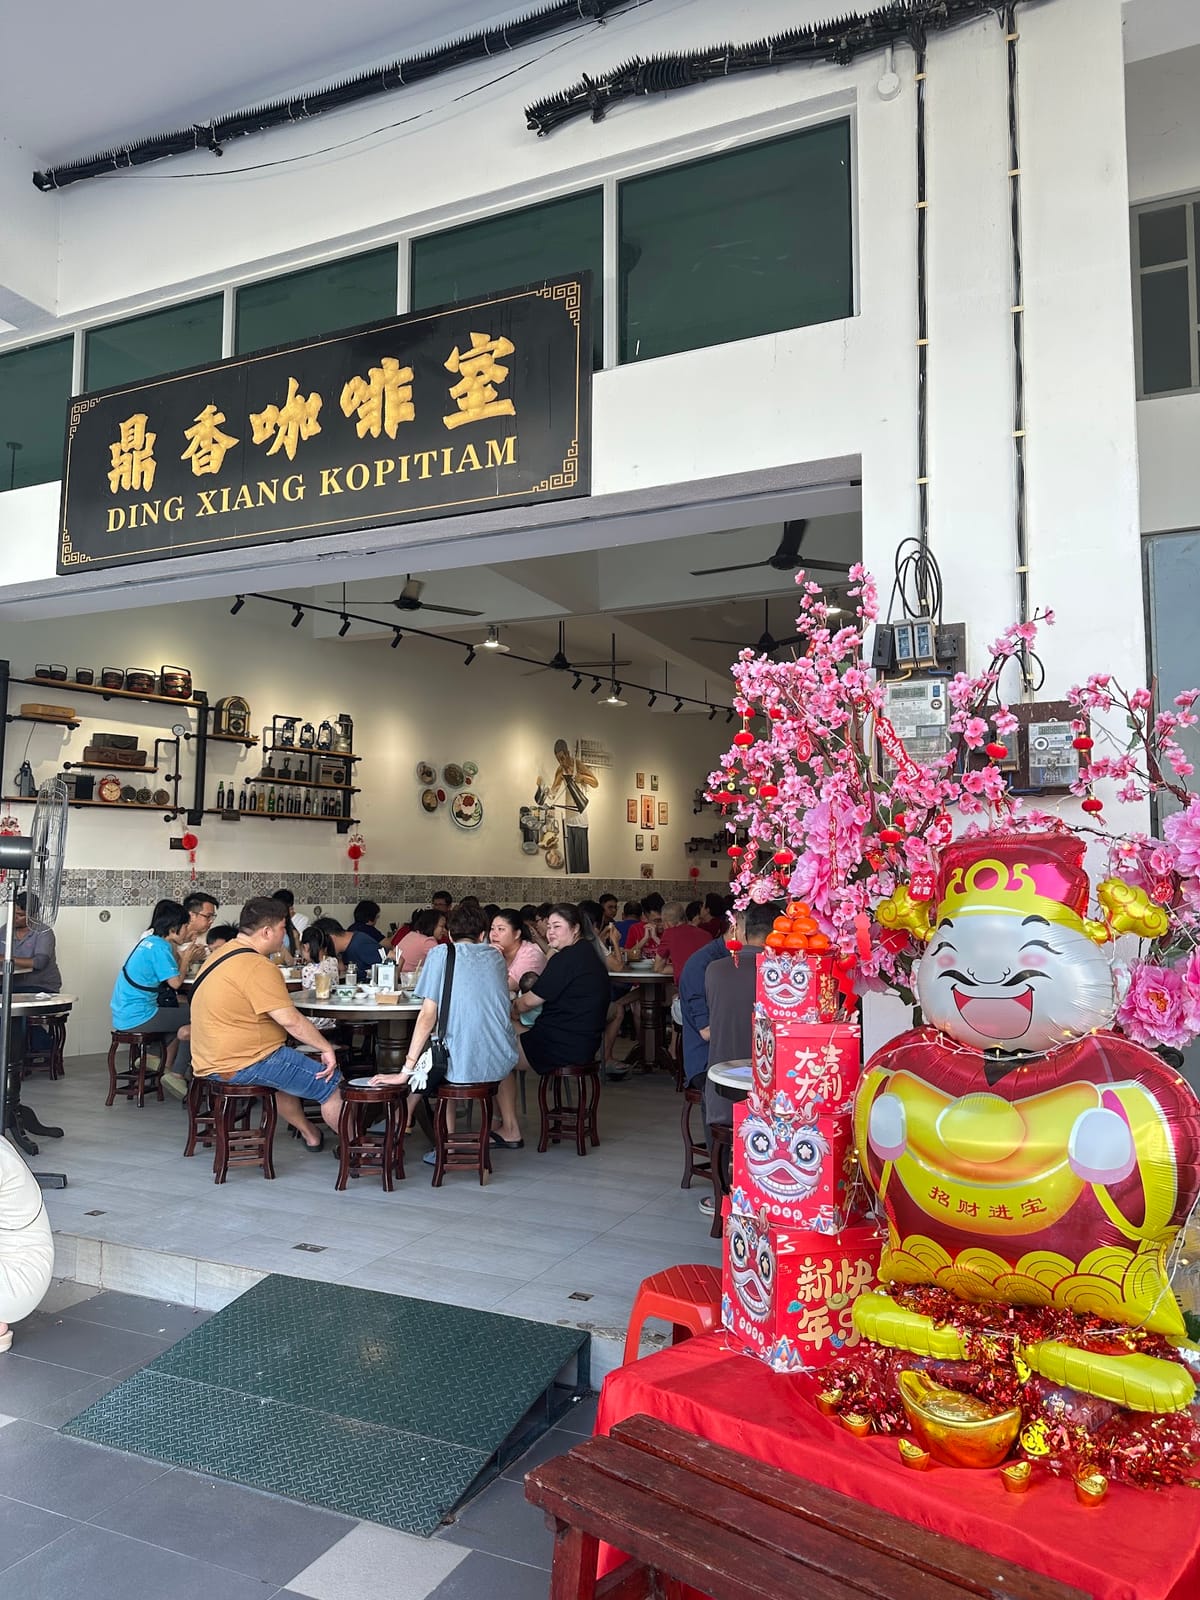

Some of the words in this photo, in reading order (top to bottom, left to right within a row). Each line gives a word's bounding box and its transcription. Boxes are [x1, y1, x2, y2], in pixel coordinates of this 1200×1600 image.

[106, 331, 517, 494] 鼎香咖啡室
[105, 495, 185, 533] DING
[195, 473, 307, 518] XIANG
[318, 435, 518, 497] KOPITIAM
[927, 1185, 1048, 1221] 招财进宝
